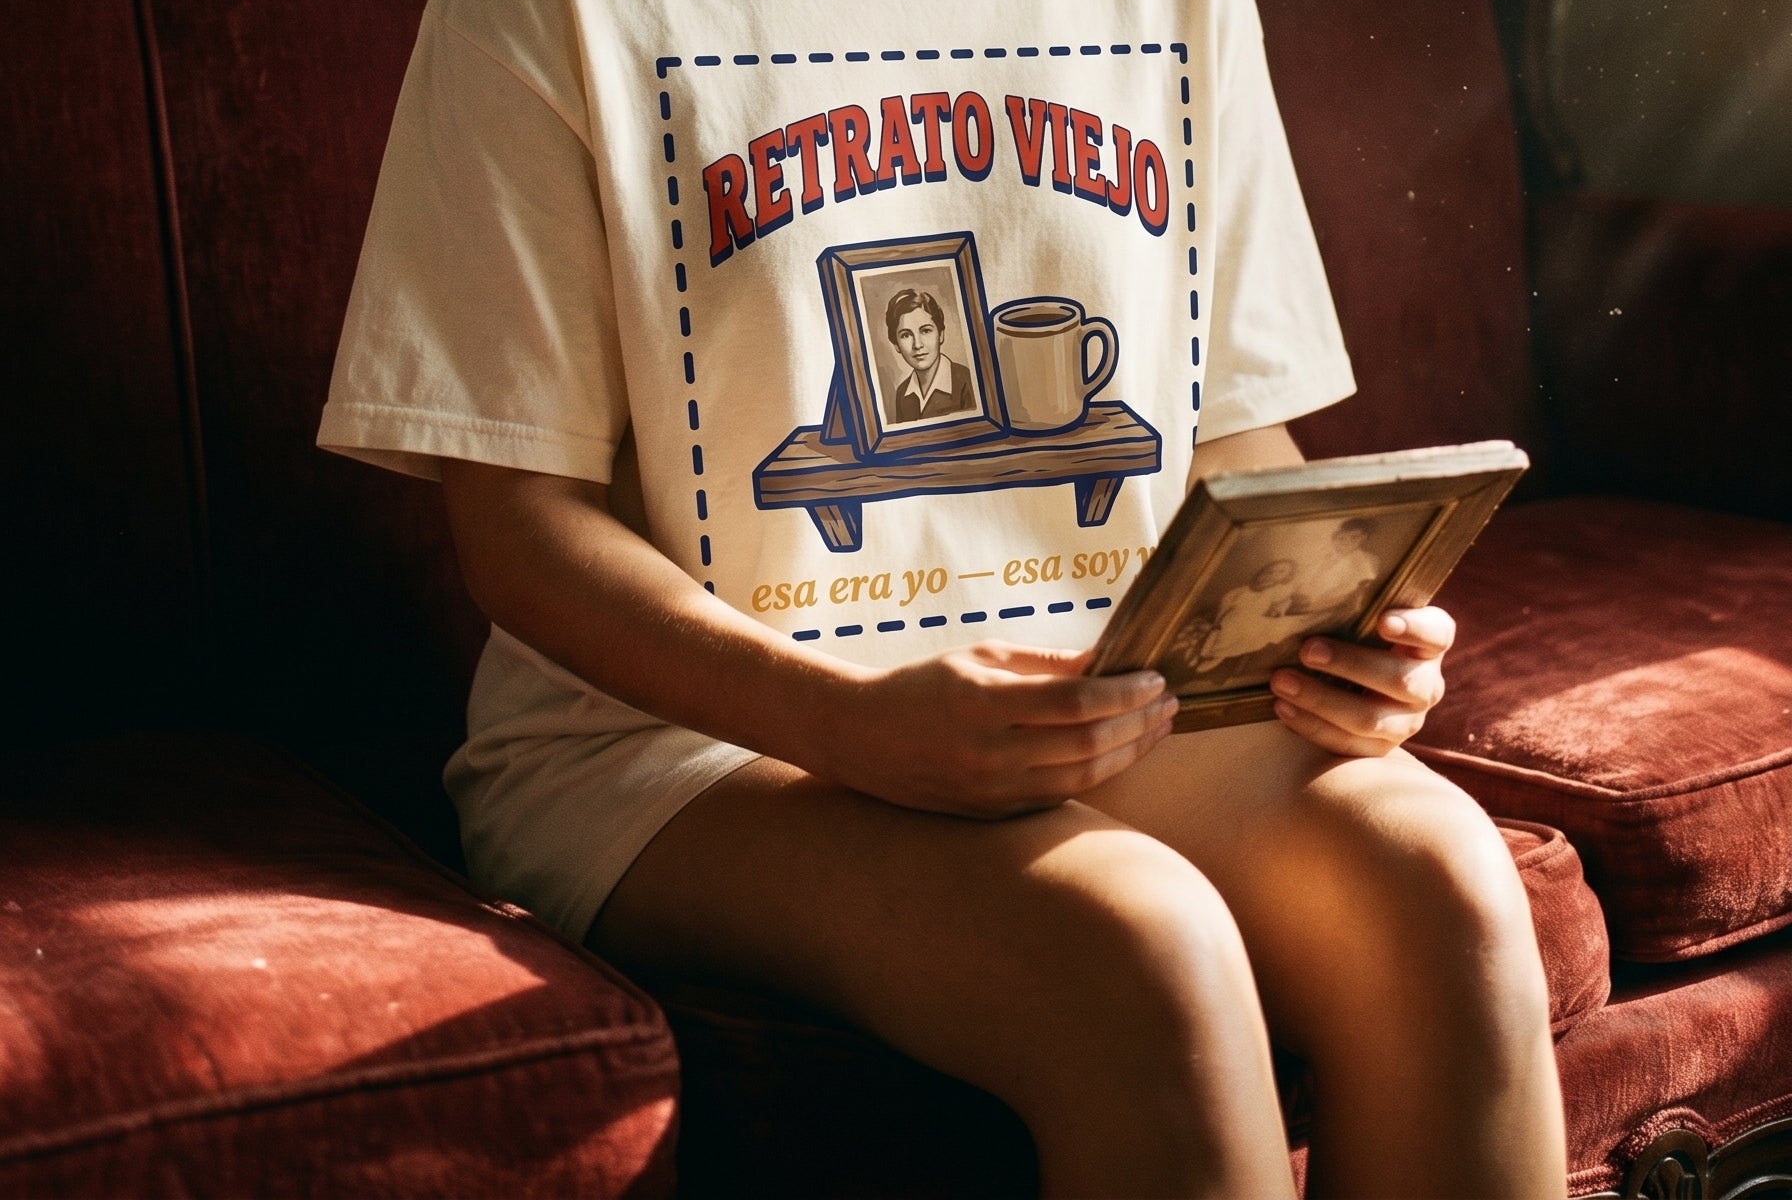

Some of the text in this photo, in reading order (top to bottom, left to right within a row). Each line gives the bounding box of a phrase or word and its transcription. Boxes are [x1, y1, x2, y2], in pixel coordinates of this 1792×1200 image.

[702, 91, 1169, 268] RETRATO VIEJO
[752, 579, 817, 612] esa
[829, 569, 892, 604] era
[899, 568, 948, 606] yo
[1003, 552, 1063, 586] esa
[1071, 548, 1129, 584] soy
